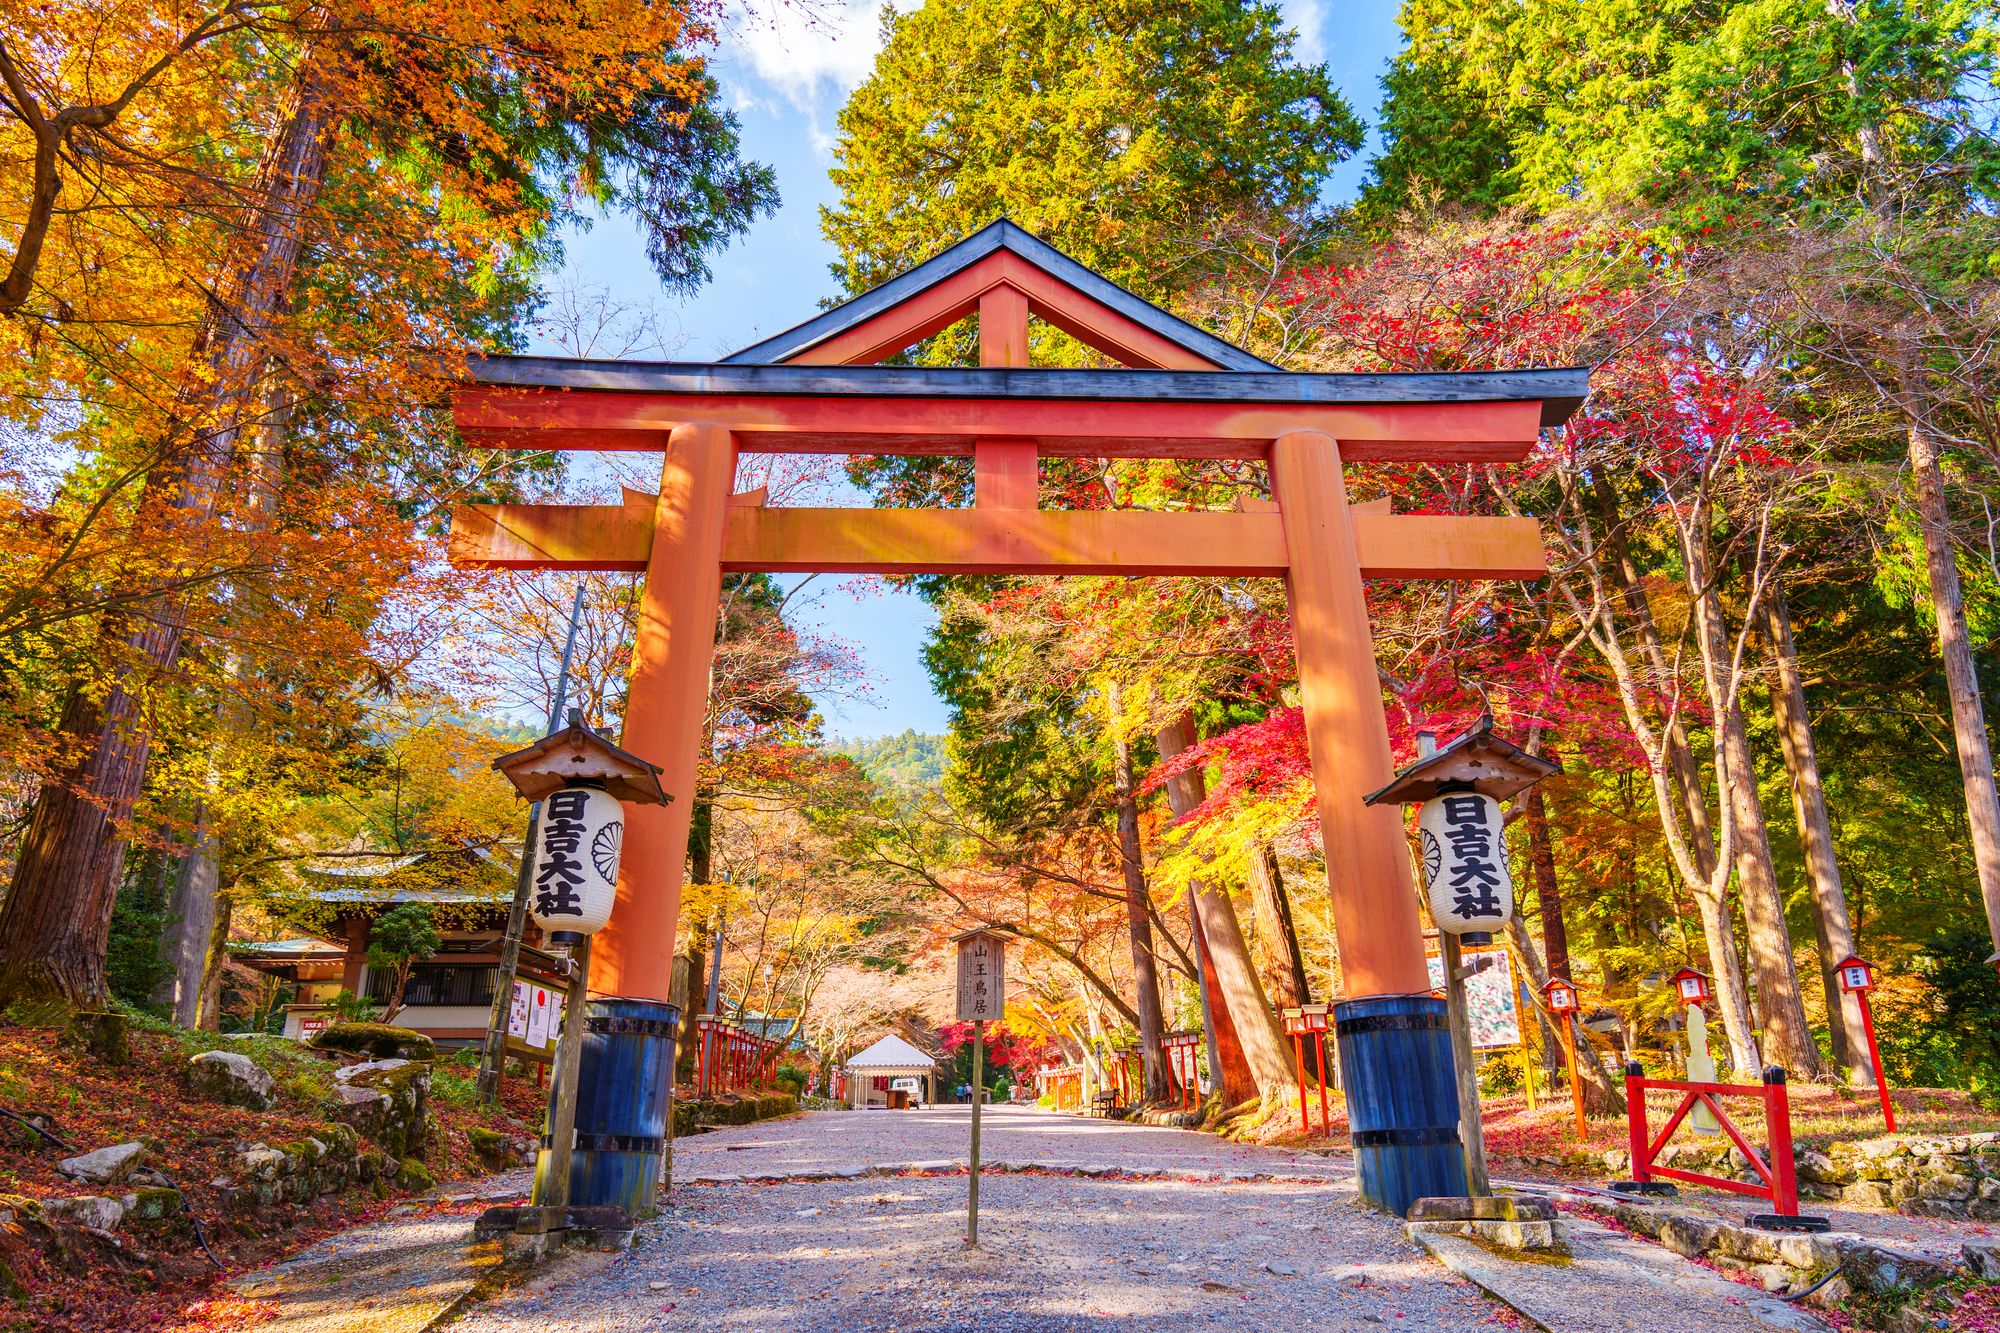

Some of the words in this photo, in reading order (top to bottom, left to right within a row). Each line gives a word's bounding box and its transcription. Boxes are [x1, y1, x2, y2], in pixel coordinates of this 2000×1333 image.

[535, 791, 590, 917] 日吉大社
[1442, 796, 1503, 919] 日吉大社
[974, 945, 987, 1014] 山王鳥居
